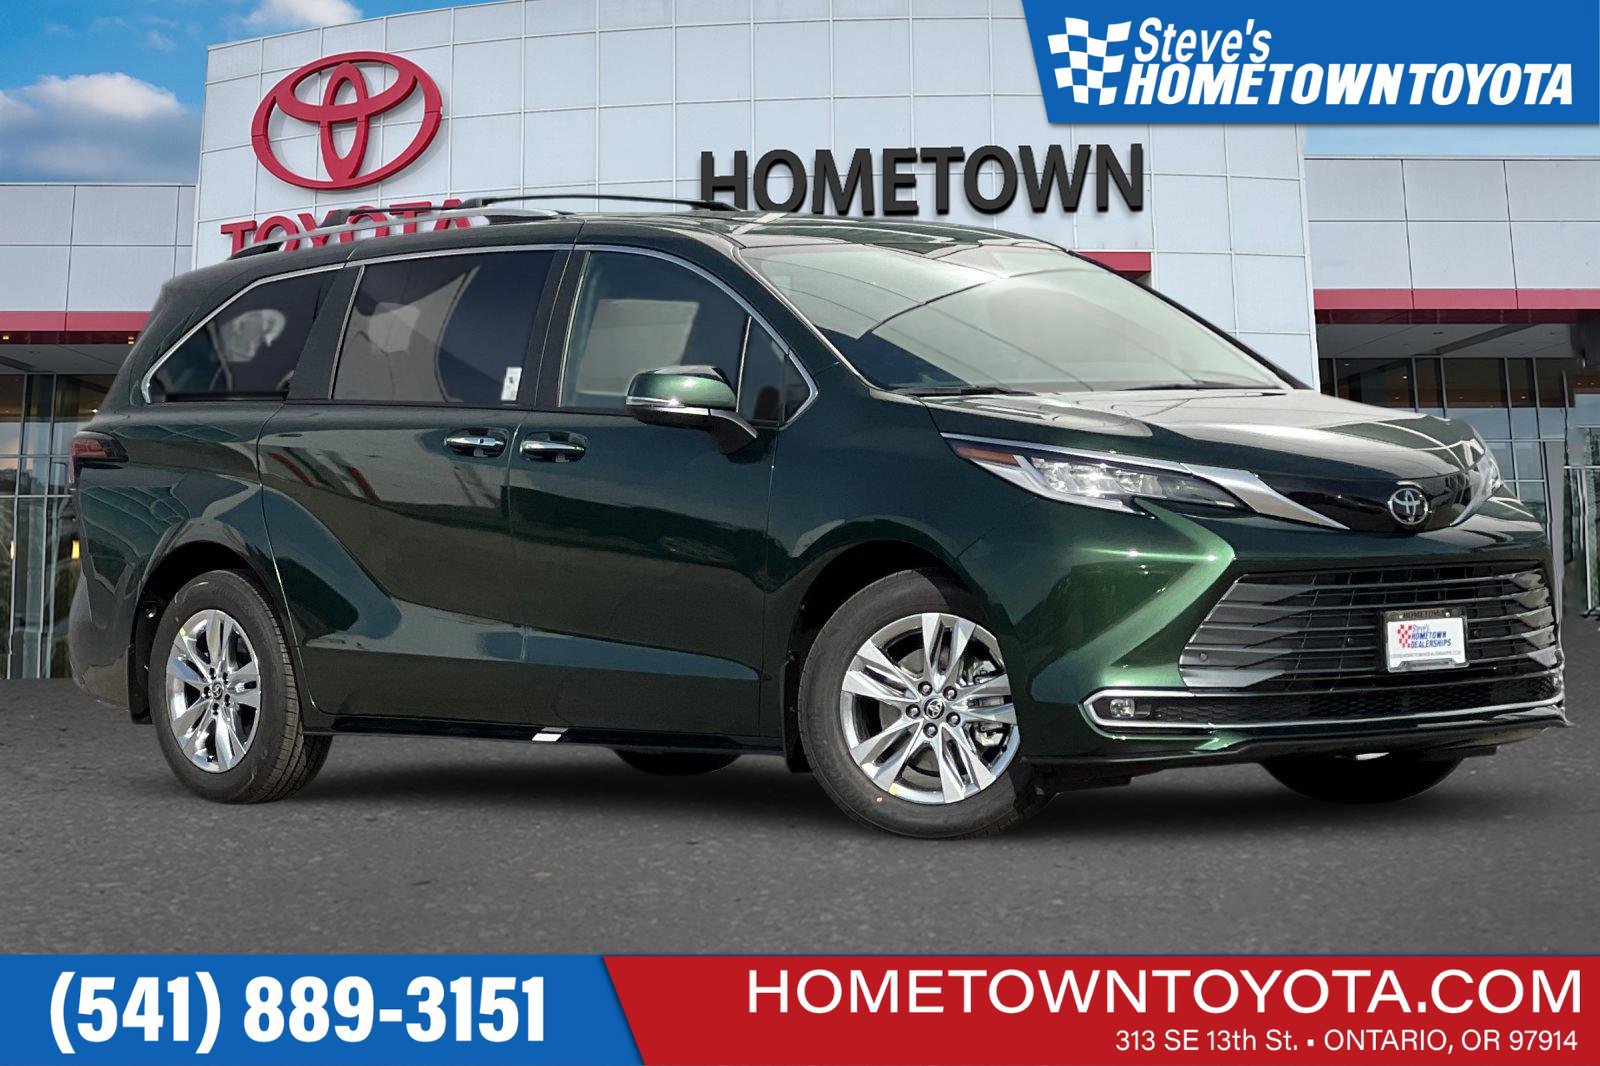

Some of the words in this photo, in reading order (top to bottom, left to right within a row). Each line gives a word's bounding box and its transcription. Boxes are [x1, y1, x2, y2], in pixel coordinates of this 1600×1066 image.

[700, 143, 1144, 215] HOMETOWN
[1411, 631, 1447, 640] HOMETOWN
[1411, 638, 1452, 649] DEALERSHIPS
